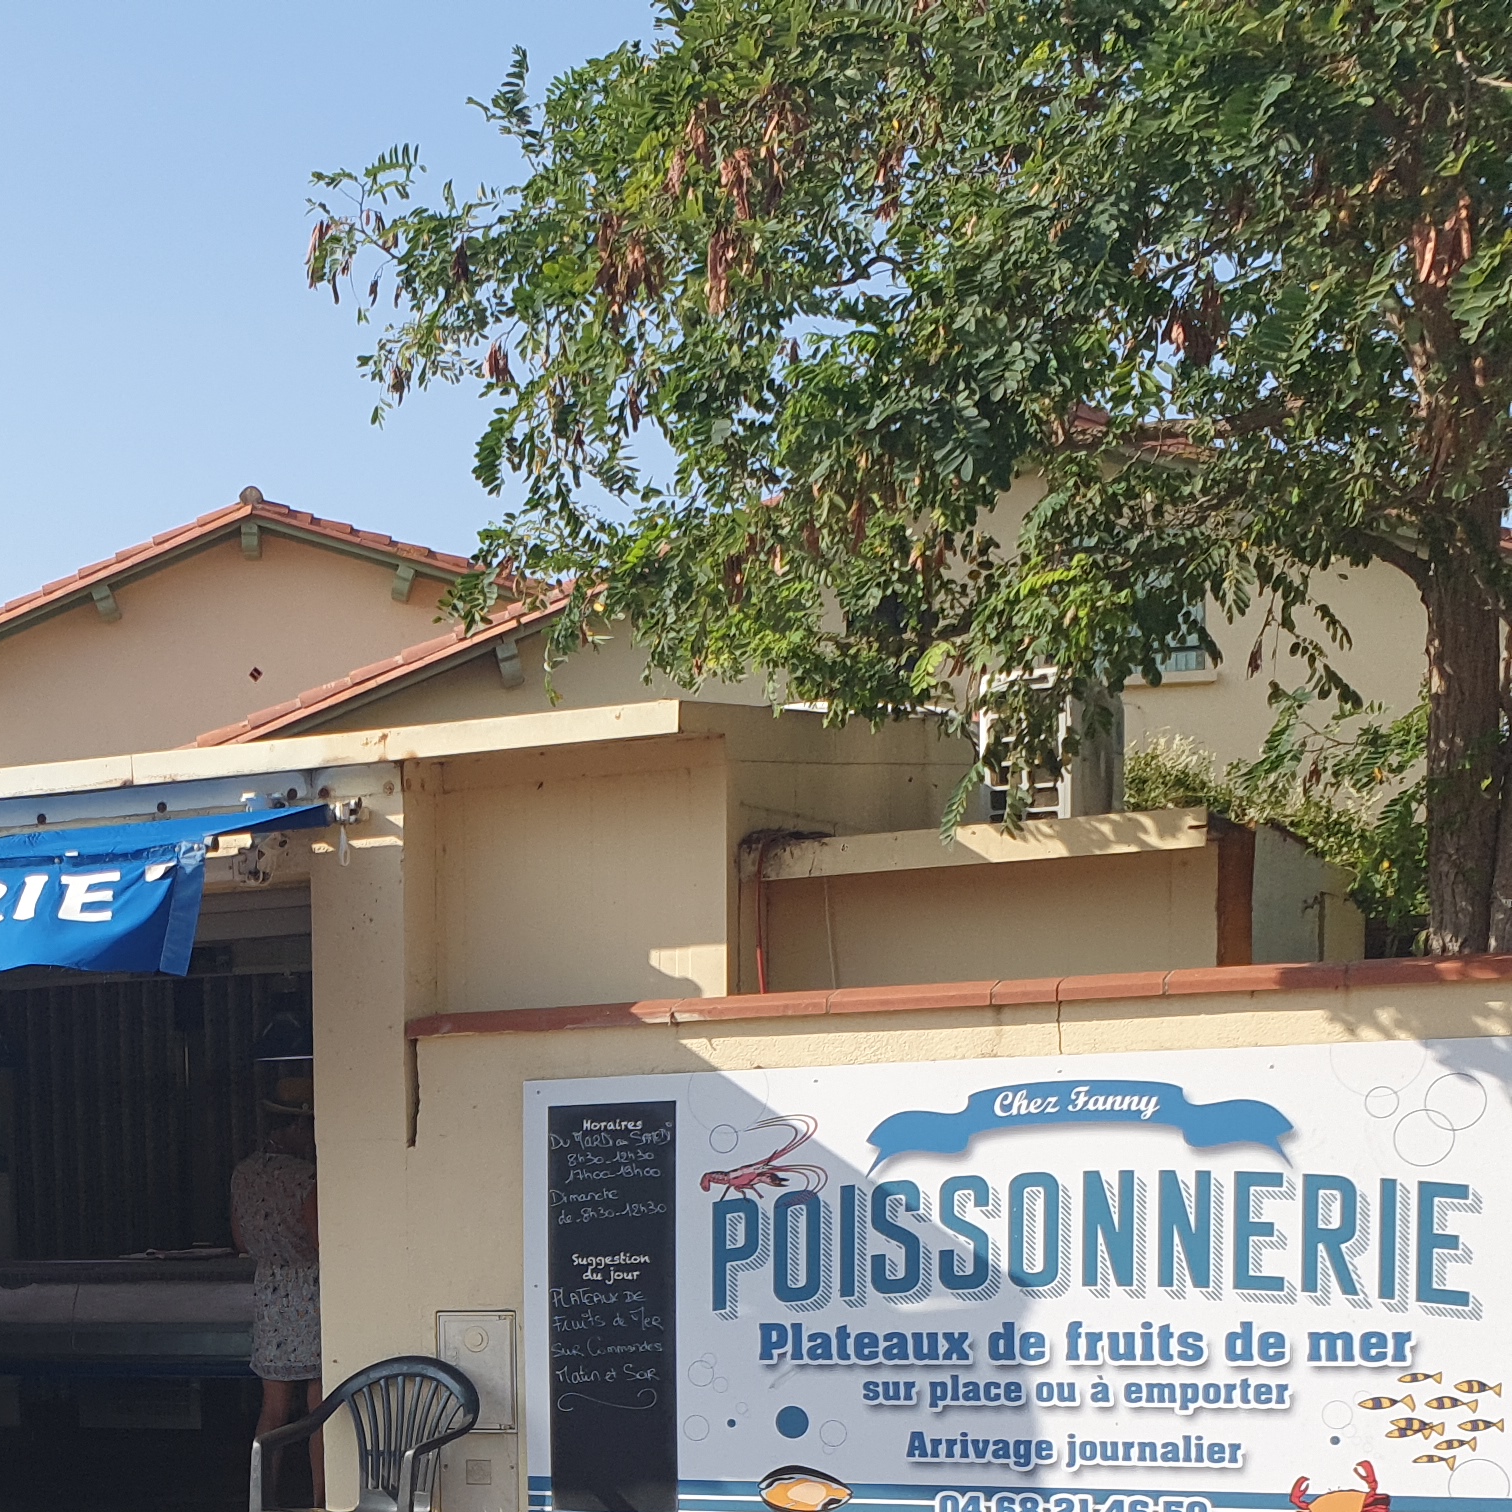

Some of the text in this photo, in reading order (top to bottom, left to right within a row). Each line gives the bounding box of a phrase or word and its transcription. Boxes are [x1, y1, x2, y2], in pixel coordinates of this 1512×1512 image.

[993, 1085, 1160, 1120] Chez Fanny
[582, 1119, 643, 1131] Horaires
[571, 1252, 651, 1269] Suggestion
[711, 1169, 1483, 1322] POISSONNERIE
[582, 1267, 640, 1285] du jour
[759, 1320, 1413, 1363] Plateaux de fruits de mer
[862, 1374, 1289, 1411] sur place ou à emporter
[905, 1431, 1242, 1469] Arrivage journalier
